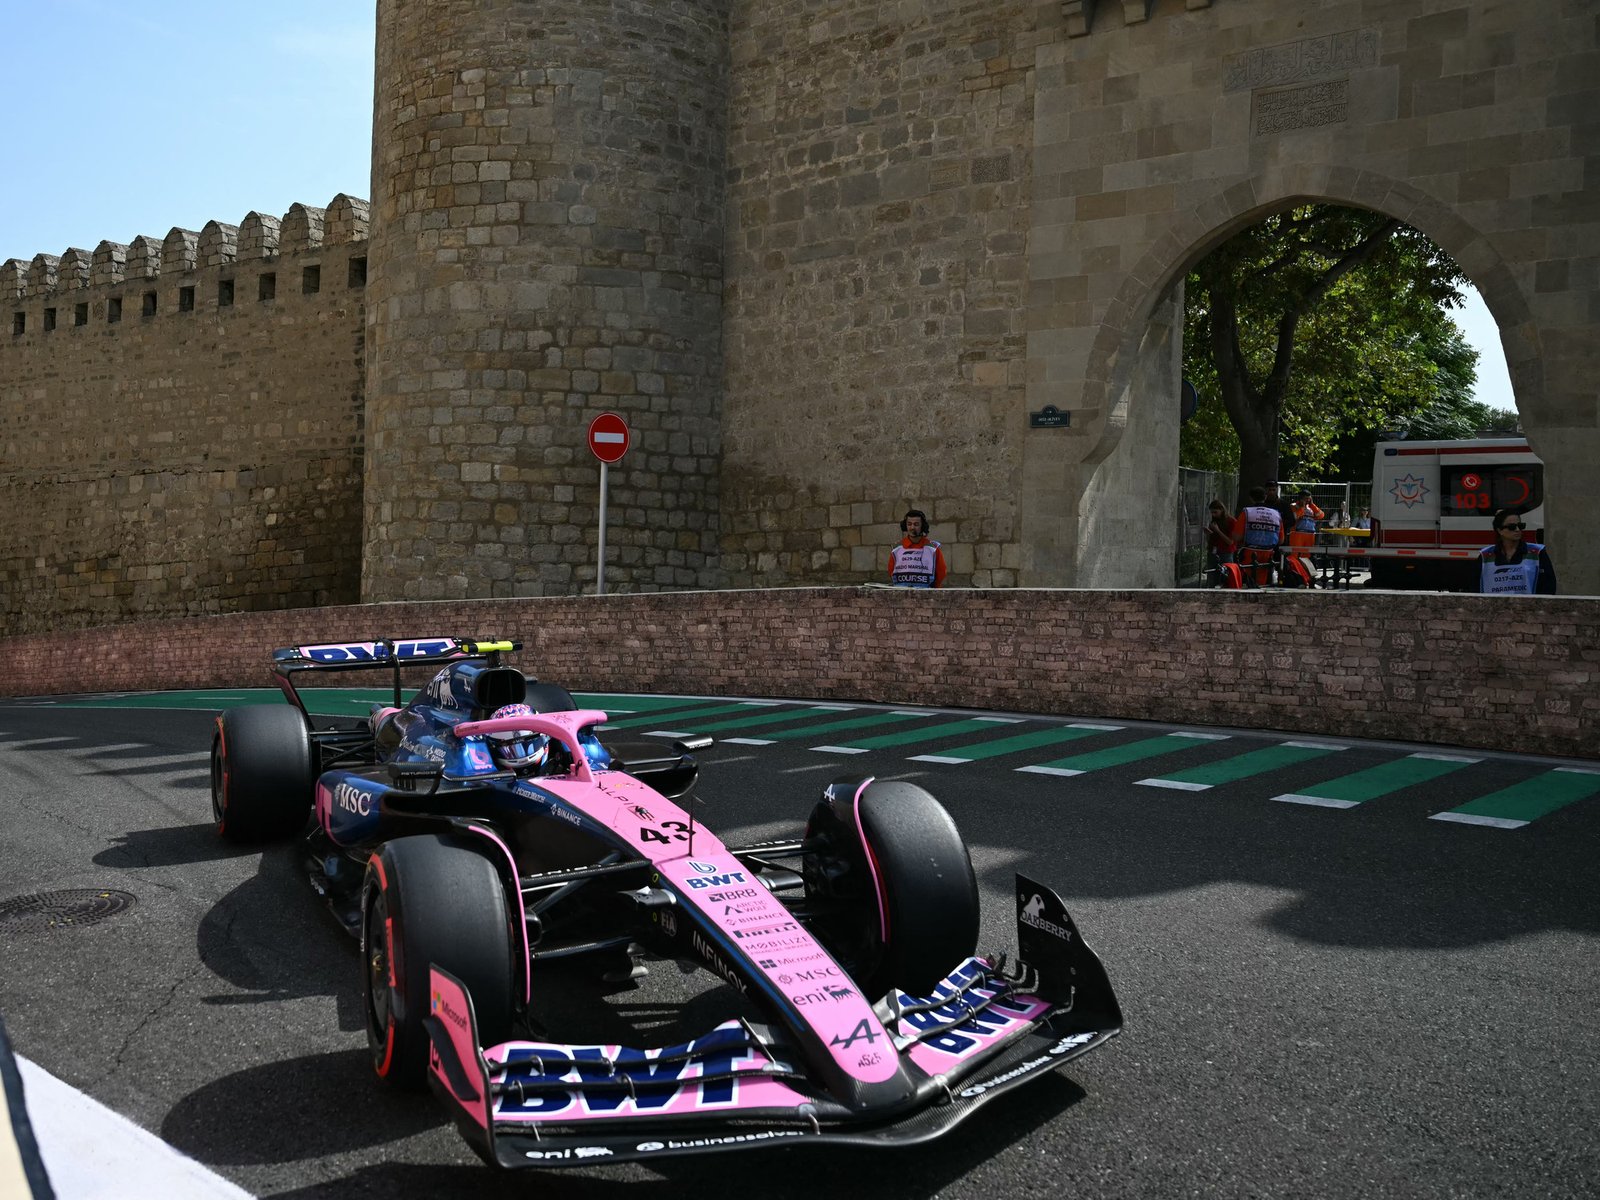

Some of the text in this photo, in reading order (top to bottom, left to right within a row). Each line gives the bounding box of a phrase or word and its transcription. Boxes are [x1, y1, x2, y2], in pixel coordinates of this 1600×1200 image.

[1455, 493, 1489, 509] 103
[897, 574, 928, 583] COURSE
[340, 783, 372, 817] MSC
[557, 807, 582, 827] BINANCE
[640, 821, 697, 845] 43
[685, 872, 747, 890] BWT
[724, 888, 758, 901] BRB
[738, 912, 785, 923] BINANCE
[1019, 910, 1073, 943] OAKBERRY
[733, 922, 798, 938] PIRELLI
[777, 952, 824, 966] Microsoft
[795, 966, 842, 982] MSC
[792, 988, 828, 1006] eni
[441, 999, 468, 1032] Microsoft
[495, 1022, 755, 1115] BWT
